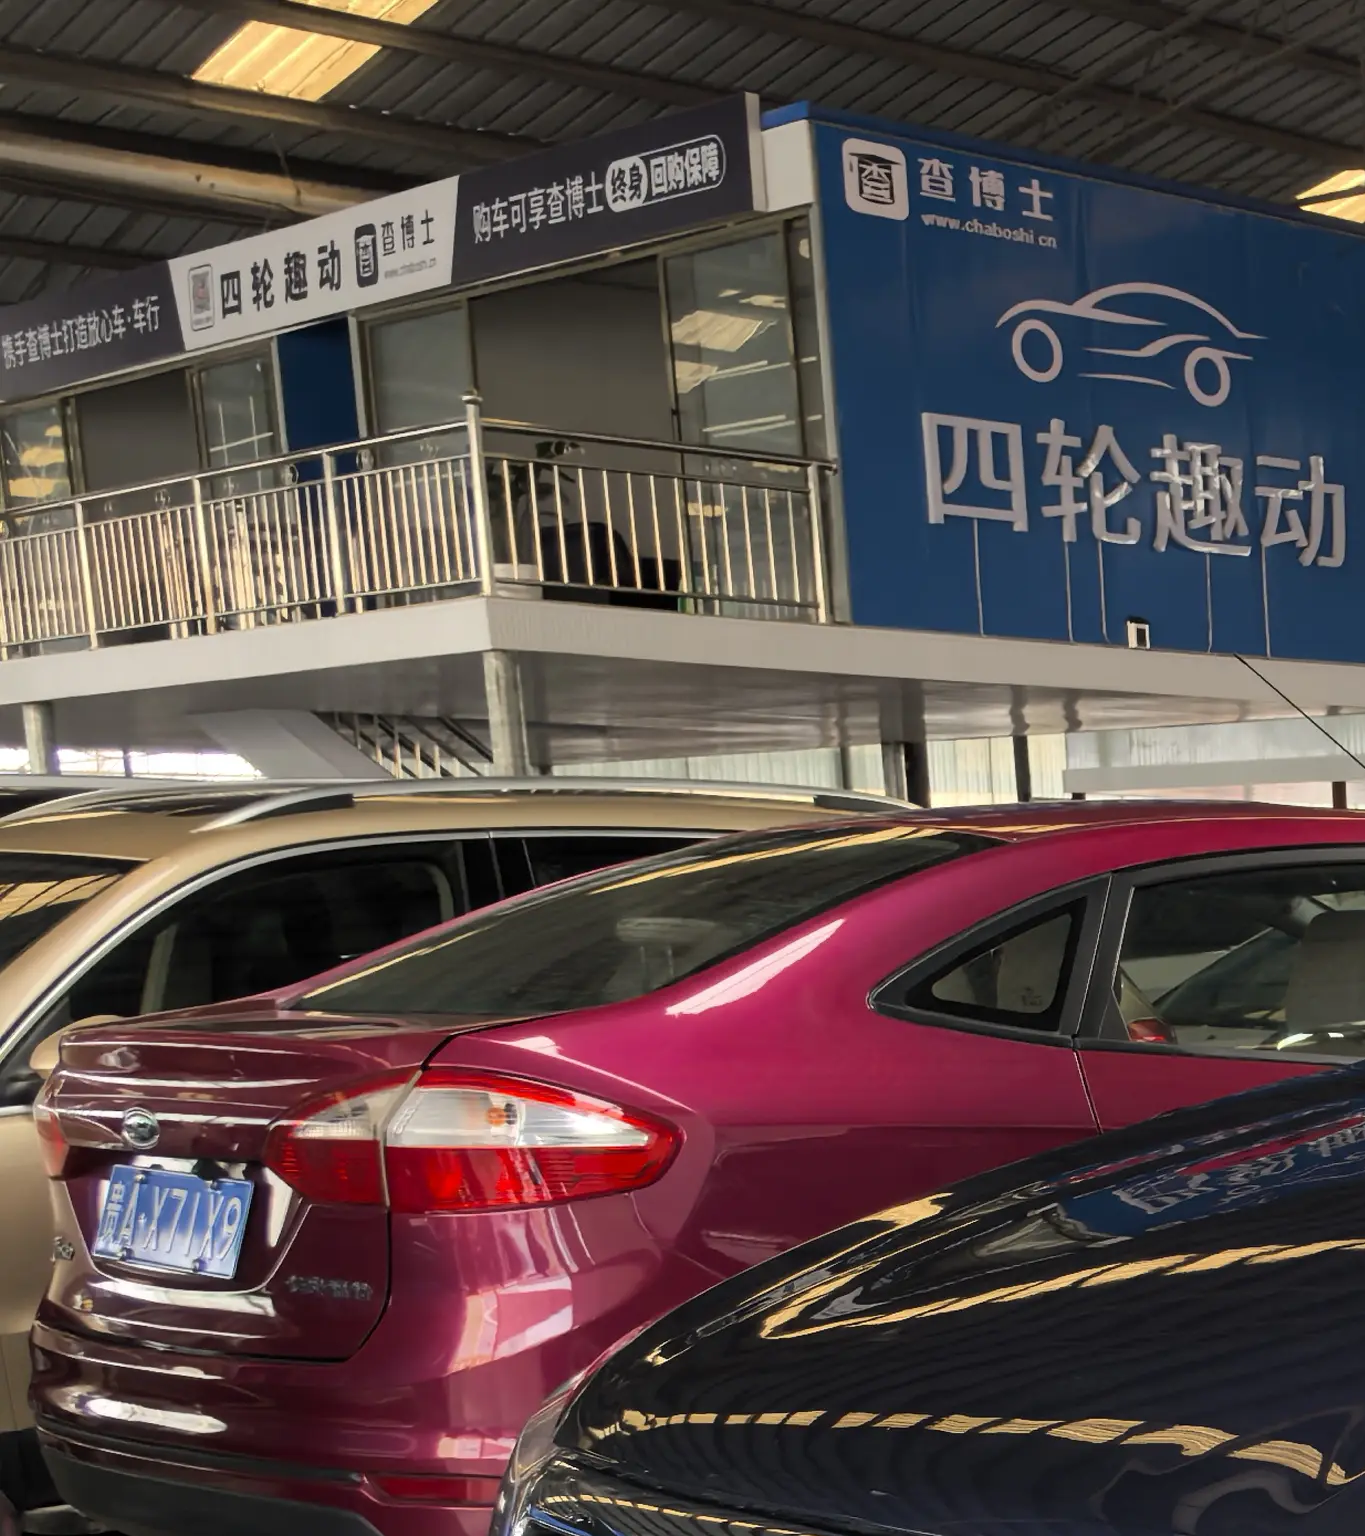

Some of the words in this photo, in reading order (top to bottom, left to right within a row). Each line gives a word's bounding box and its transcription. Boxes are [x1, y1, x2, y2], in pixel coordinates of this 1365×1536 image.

[917, 157, 1054, 222] 查博士
[380, 209, 435, 257] 查博士
[220, 240, 342, 320] 四轮趣动
[921, 412, 1347, 568] 四轮趣动
